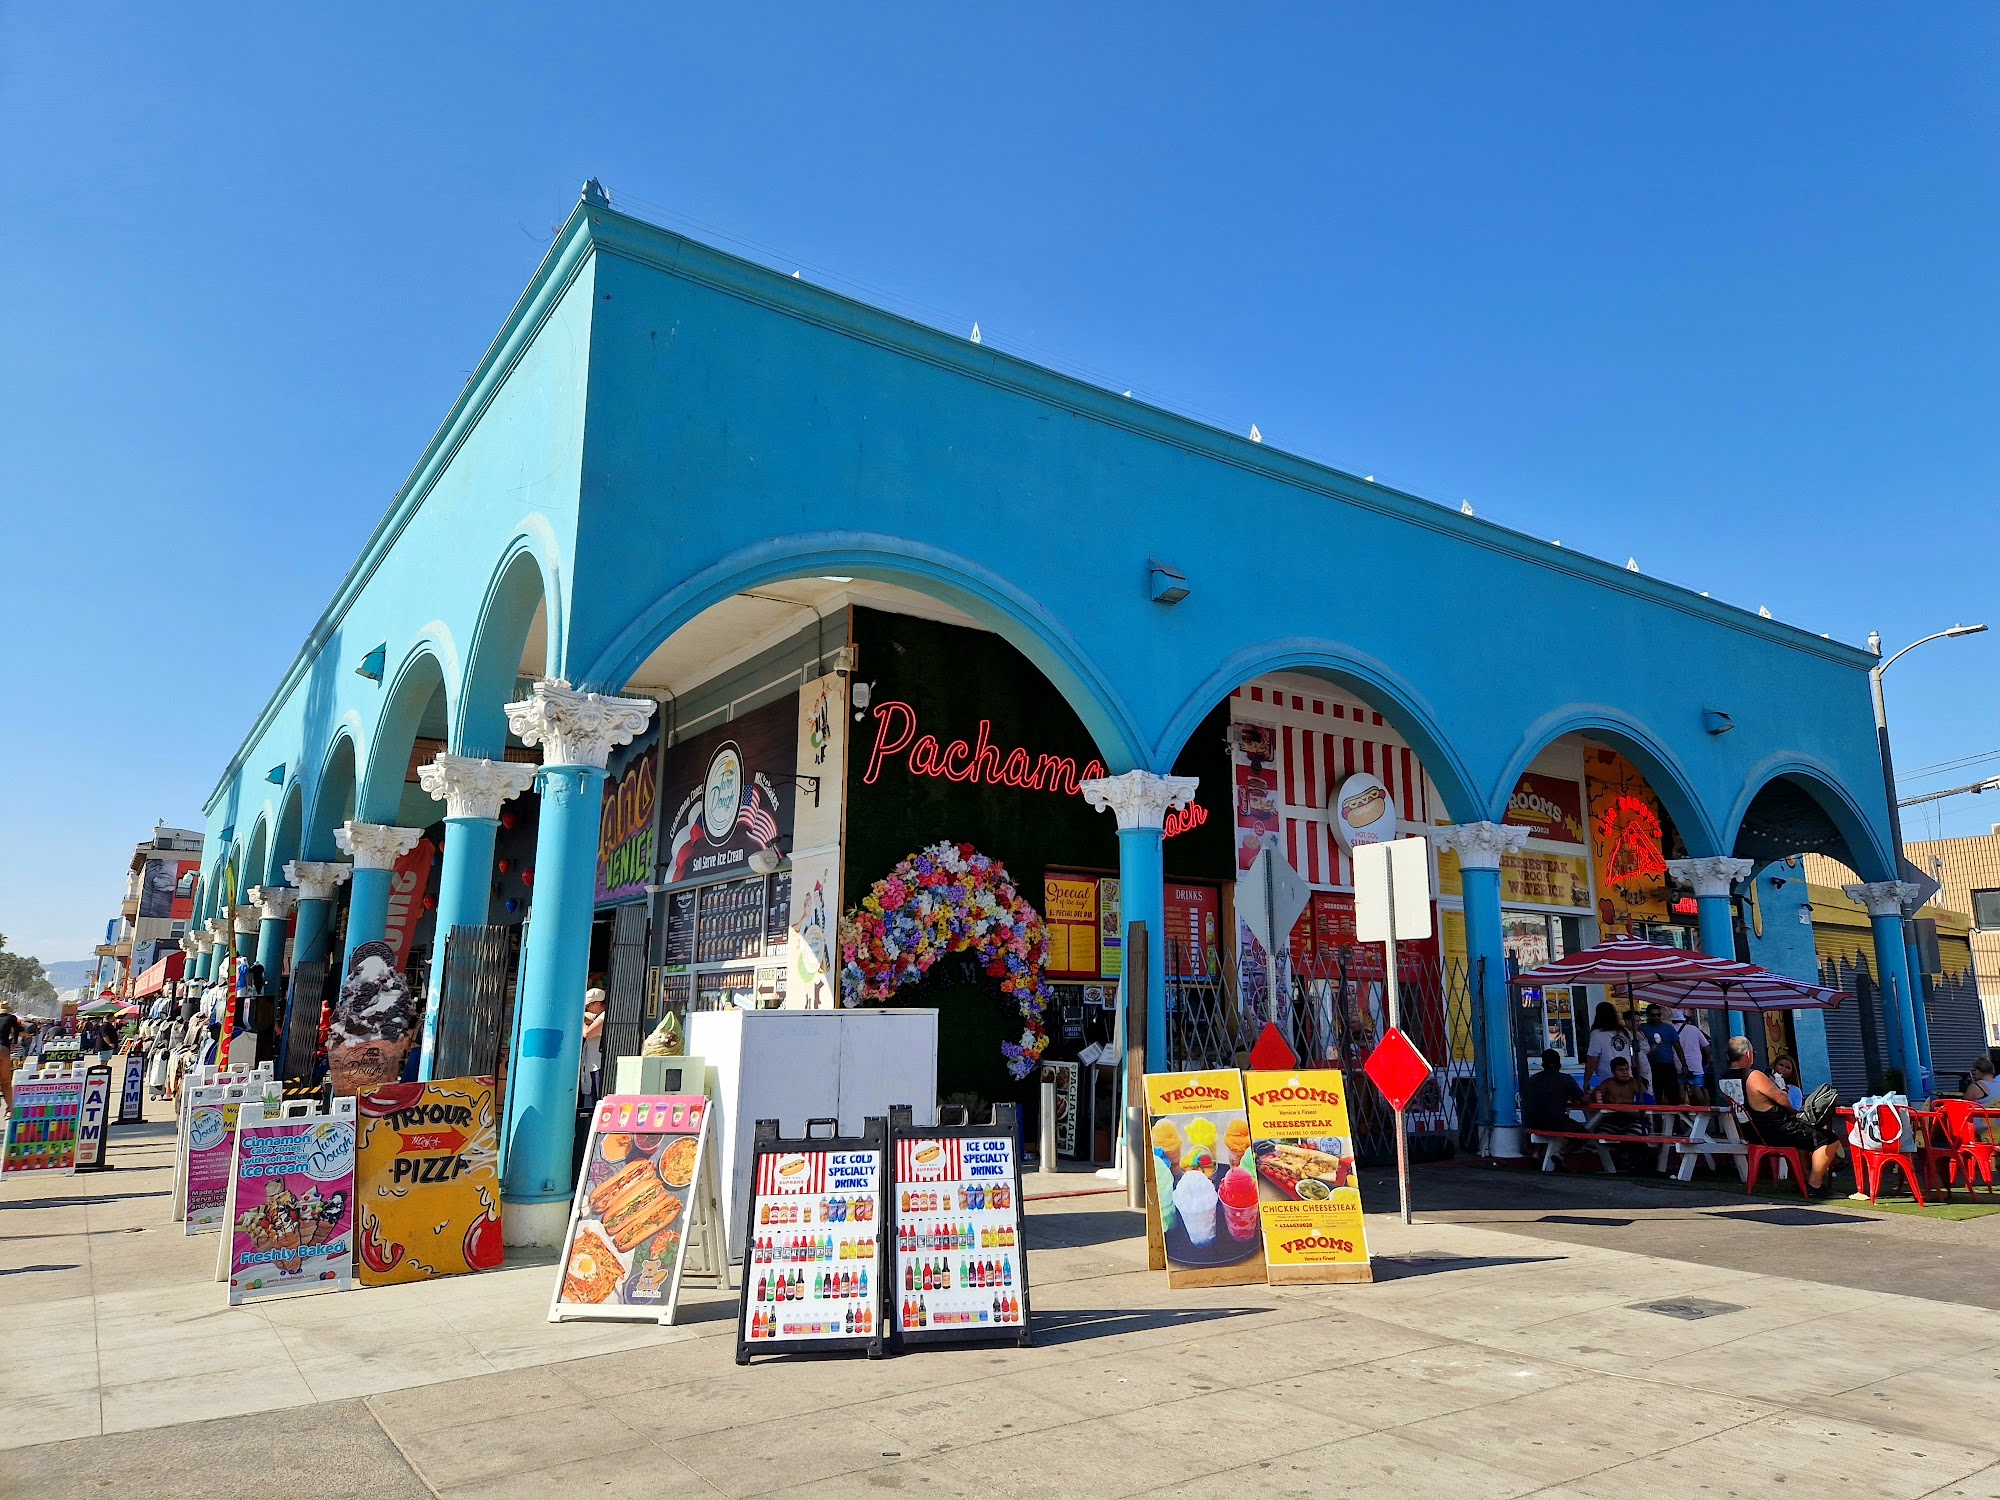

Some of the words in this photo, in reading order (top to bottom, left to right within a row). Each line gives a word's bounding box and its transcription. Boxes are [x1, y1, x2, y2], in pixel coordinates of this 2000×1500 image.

[1509, 793, 1562, 823] ROOMS
[702, 852, 716, 869] Serve
[716, 851, 727, 866] Ice
[727, 848, 744, 864] Cream
[1500, 855, 1568, 874] HEESESTEAK
[1046, 882, 1091, 903] Special
[1176, 889, 1203, 901] DRINKS
[125, 1067, 140, 1103] ATM
[1160, 1086, 1230, 1104] VROOMS
[1250, 1086, 1339, 1107] VROOMS
[80, 1090, 103, 1140] ATM
[1067, 1071, 1077, 1152] PACHAMAMA
[1263, 1120, 1333, 1129] CHEESESTEAK
[242, 1134, 312, 1149] Cinnamon
[311, 1128, 342, 1152] Turn
[966, 1141, 980, 1152] ICE
[983, 1141, 1006, 1152] COLD
[251, 1147, 273, 1155] cake
[307, 1135, 354, 1173] Dough
[963, 1152, 1010, 1164] SPECIALTY
[243, 1157, 265, 1166] with
[265, 1155, 283, 1164] soft
[283, 1153, 309, 1162] serve
[832, 1154, 847, 1165] ICE
[850, 1154, 872, 1165] COLD
[241, 1165, 263, 1177] ice
[264, 1162, 310, 1176] cream
[394, 1154, 471, 1184] PIZZA
[828, 1165, 876, 1177] SPECIALTY
[970, 1165, 1004, 1176] DRINKS
[835, 1178, 869, 1189] DRINKS
[192, 1189, 212, 1197] Made
[192, 1202, 206, 1210] and
[1263, 1205, 1300, 1213] CHICKEN
[1302, 1203, 1357, 1213] CHEESESTEAK
[240, 1248, 296, 1265] Freshly
[298, 1240, 345, 1258] Baked
[1281, 1236, 1354, 1254] VROOMS
